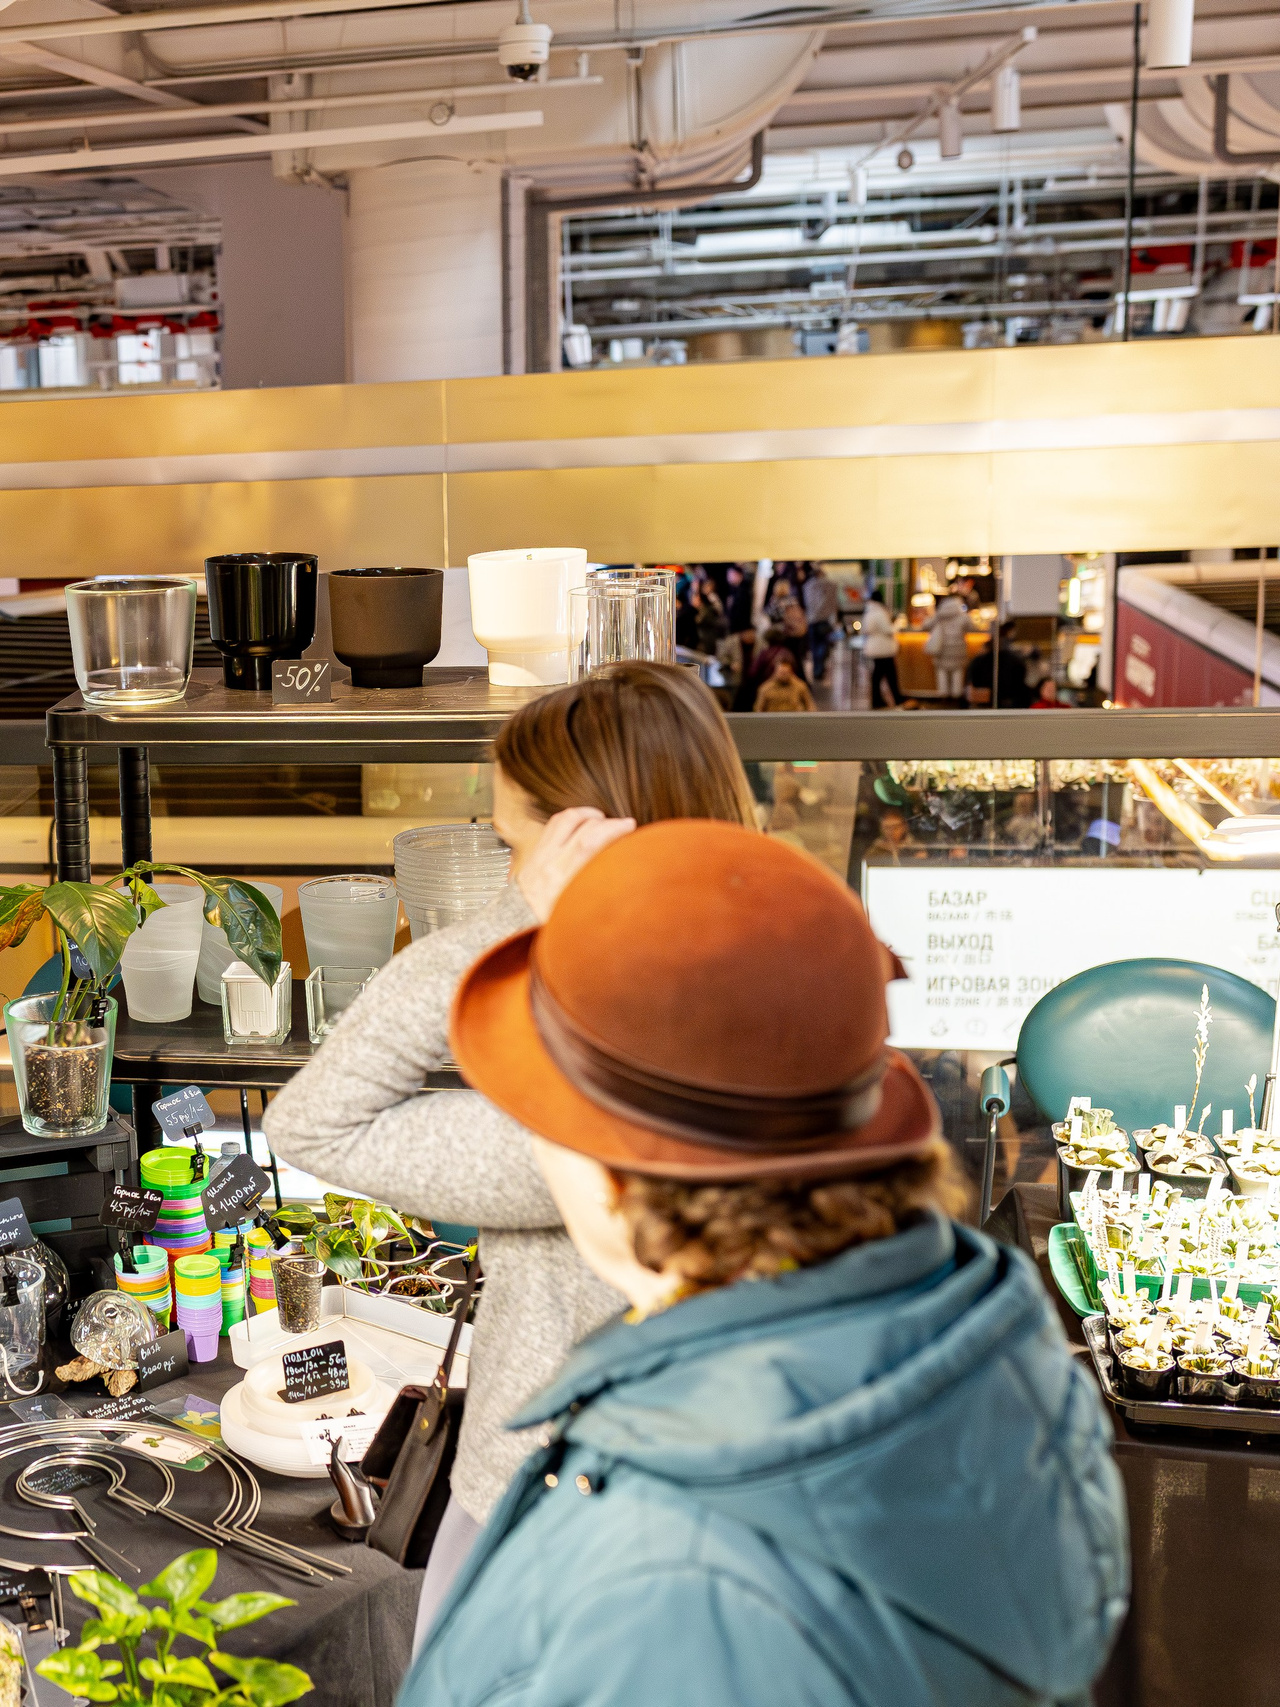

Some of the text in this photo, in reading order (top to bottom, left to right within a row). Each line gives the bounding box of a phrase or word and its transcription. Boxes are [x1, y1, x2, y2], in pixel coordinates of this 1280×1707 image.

[275, 662, 329, 697] -50%
[928, 889, 988, 907] БАЗАР
[927, 932, 994, 951] ВЫХОД
[926, 975, 1010, 994] ИГРОВАЯ
[220, 1189, 244, 1212] 1400
[140, 1342, 162, 1361] ВАЗА
